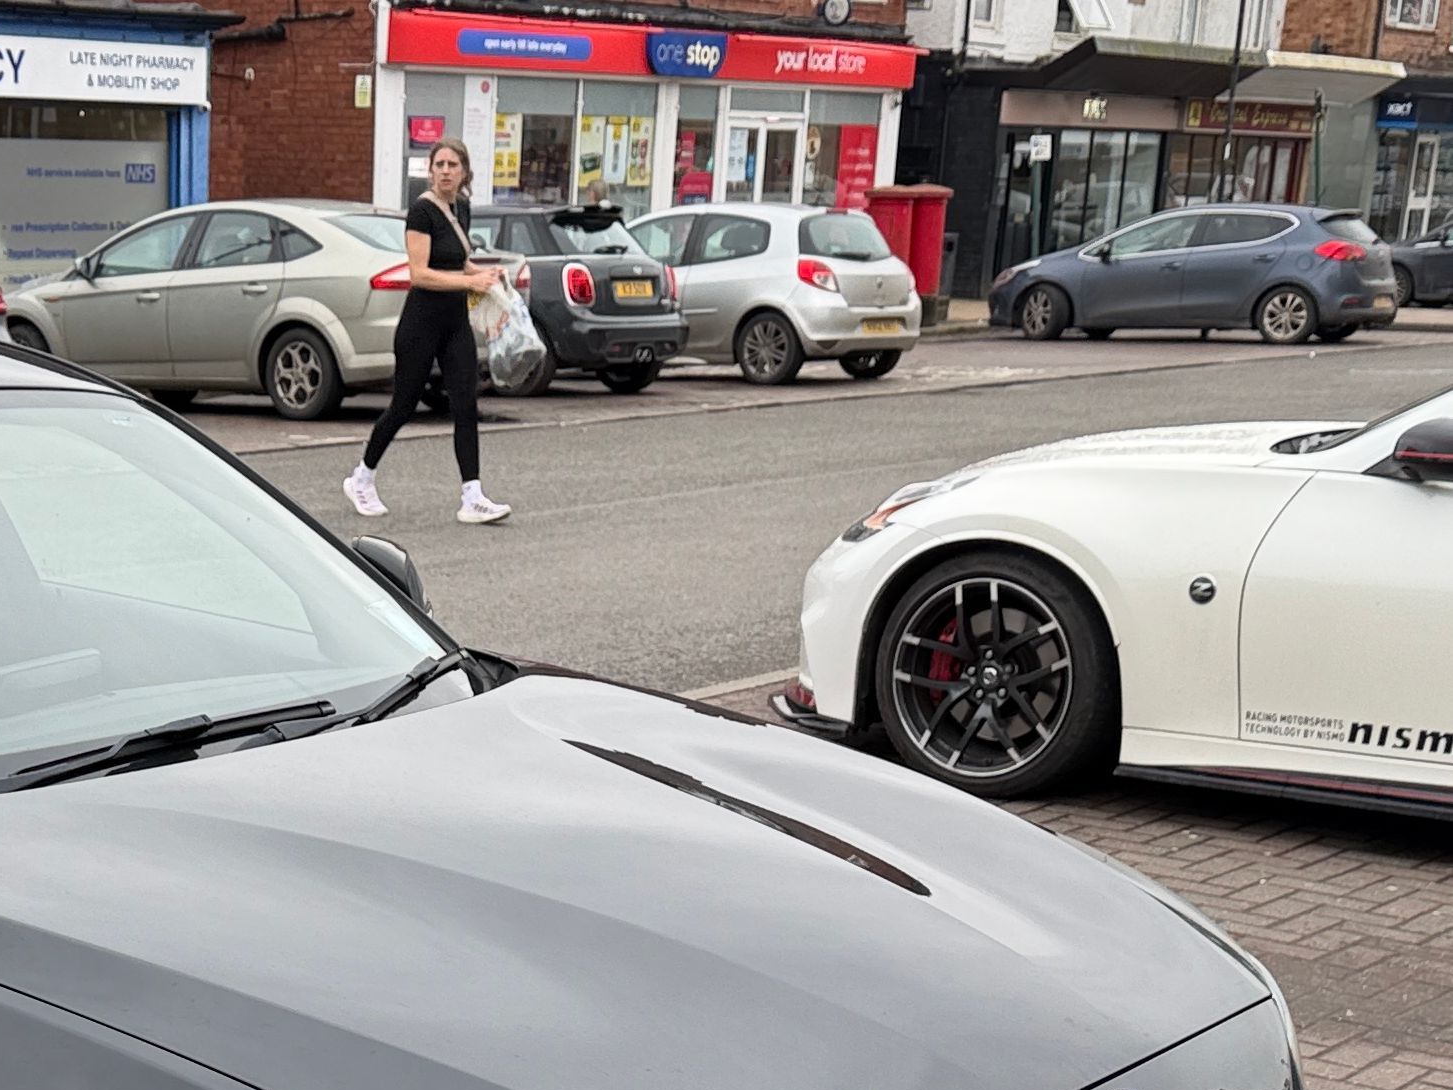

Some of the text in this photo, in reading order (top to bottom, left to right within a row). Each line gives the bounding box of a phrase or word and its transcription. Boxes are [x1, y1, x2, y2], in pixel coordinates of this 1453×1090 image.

[69, 50, 195, 71] LATE NIGHT PHARMACY
[656, 41, 721, 72] one stop
[775, 46, 867, 74] your local store
[97, 74, 147, 90] MOBILITY
[150, 76, 180, 91] SHOP
[128, 165, 153, 181] NHS
[1246, 711, 1344, 729] RACING MOTORSPORTS
[1246, 723, 1345, 742] TECHNOLOGY BY NISMO
